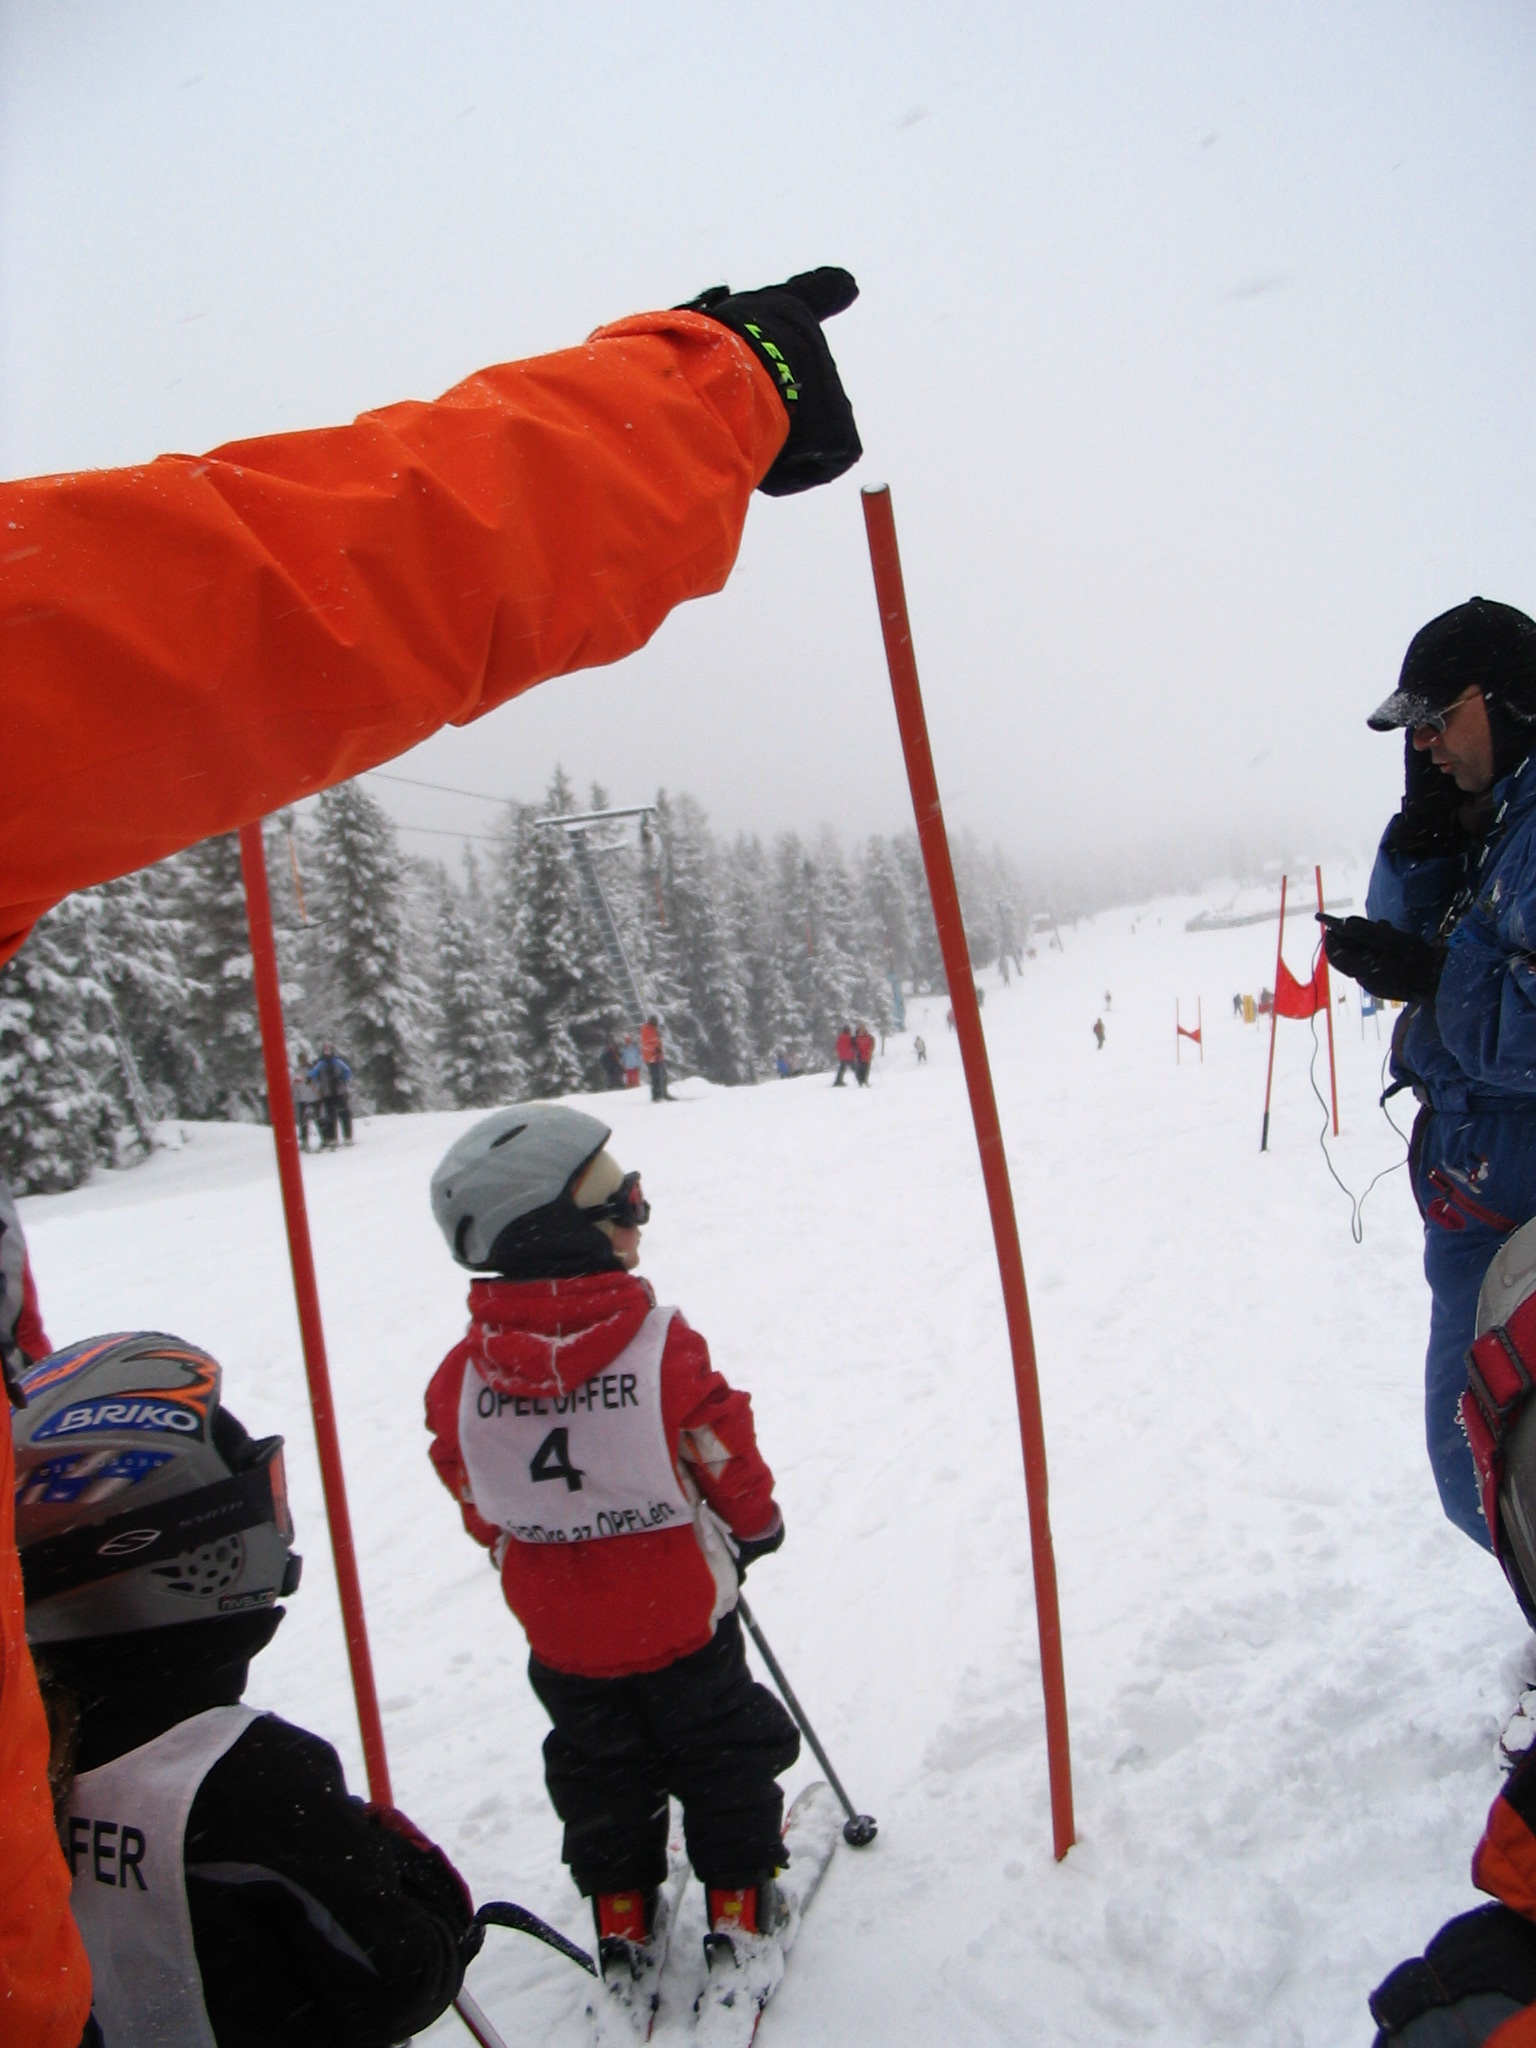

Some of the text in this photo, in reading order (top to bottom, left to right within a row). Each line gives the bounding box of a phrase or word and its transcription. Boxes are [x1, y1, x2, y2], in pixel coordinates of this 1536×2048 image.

[744, 323, 798, 400] LEKI
[57, 1404, 200, 1433] BRIKO
[477, 1387, 549, 1419] OPEL
[529, 1426, 586, 1494] 4
